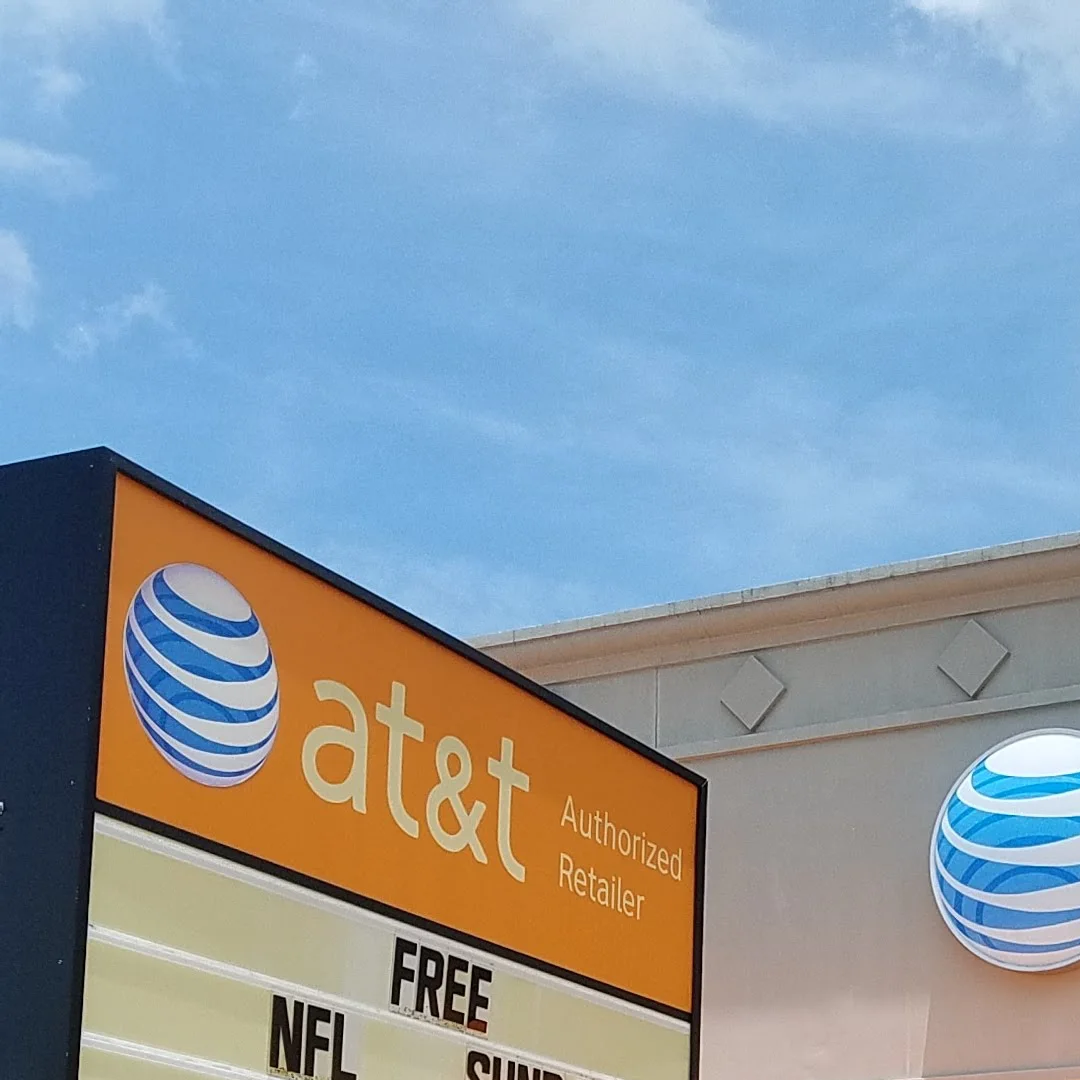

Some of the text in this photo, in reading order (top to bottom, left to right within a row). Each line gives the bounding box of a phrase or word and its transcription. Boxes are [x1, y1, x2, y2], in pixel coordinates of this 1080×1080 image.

[301, 679, 529, 883] at&t
[559, 795, 684, 882] Authorized
[557, 852, 646, 920] Retailer
[391, 937, 493, 1033] FREE
